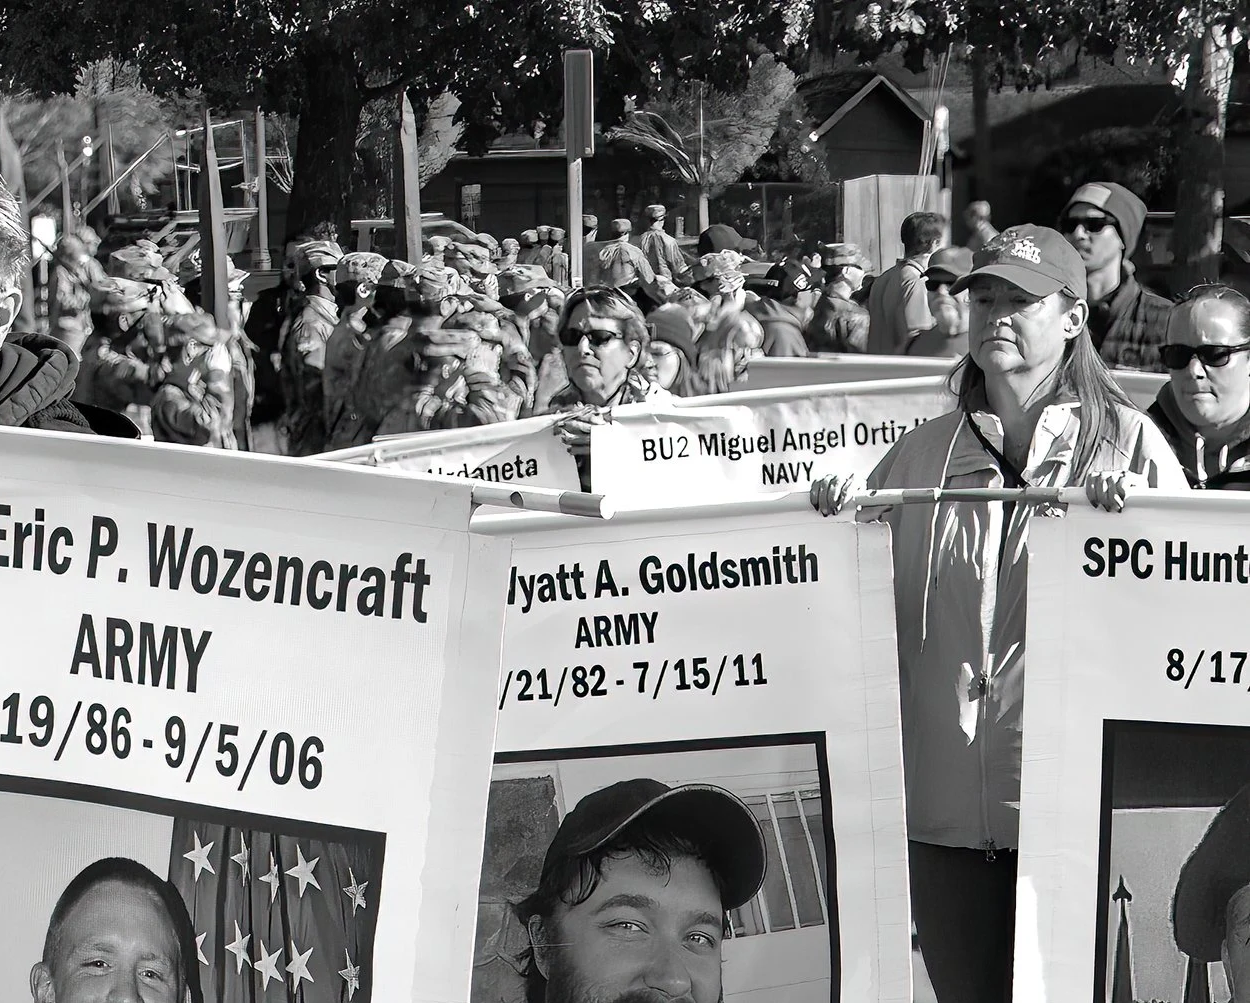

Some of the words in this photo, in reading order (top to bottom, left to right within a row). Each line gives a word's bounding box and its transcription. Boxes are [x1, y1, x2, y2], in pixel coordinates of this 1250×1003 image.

[642, 437, 689, 461] BU2
[699, 429, 775, 460] Miguel
[783, 424, 845, 454] Angel
[426, 454, 540, 484] daneta
[763, 461, 813, 485] NAVY
[87, 516, 127, 582] P.
[147, 523, 430, 623] Wozencraft
[595, 560, 628, 598] A.
[639, 545, 818, 594] Goldsmith
[1083, 537, 1153, 579] SPC
[1165, 541, 1250, 583] Hunt
[575, 612, 658, 648] ARMY
[70, 614, 212, 693] ARMY
[633, 653, 767, 699] 7/15/11
[1167, 649, 1250, 692] 8/17
[165, 716, 324, 791] 9/5/06
